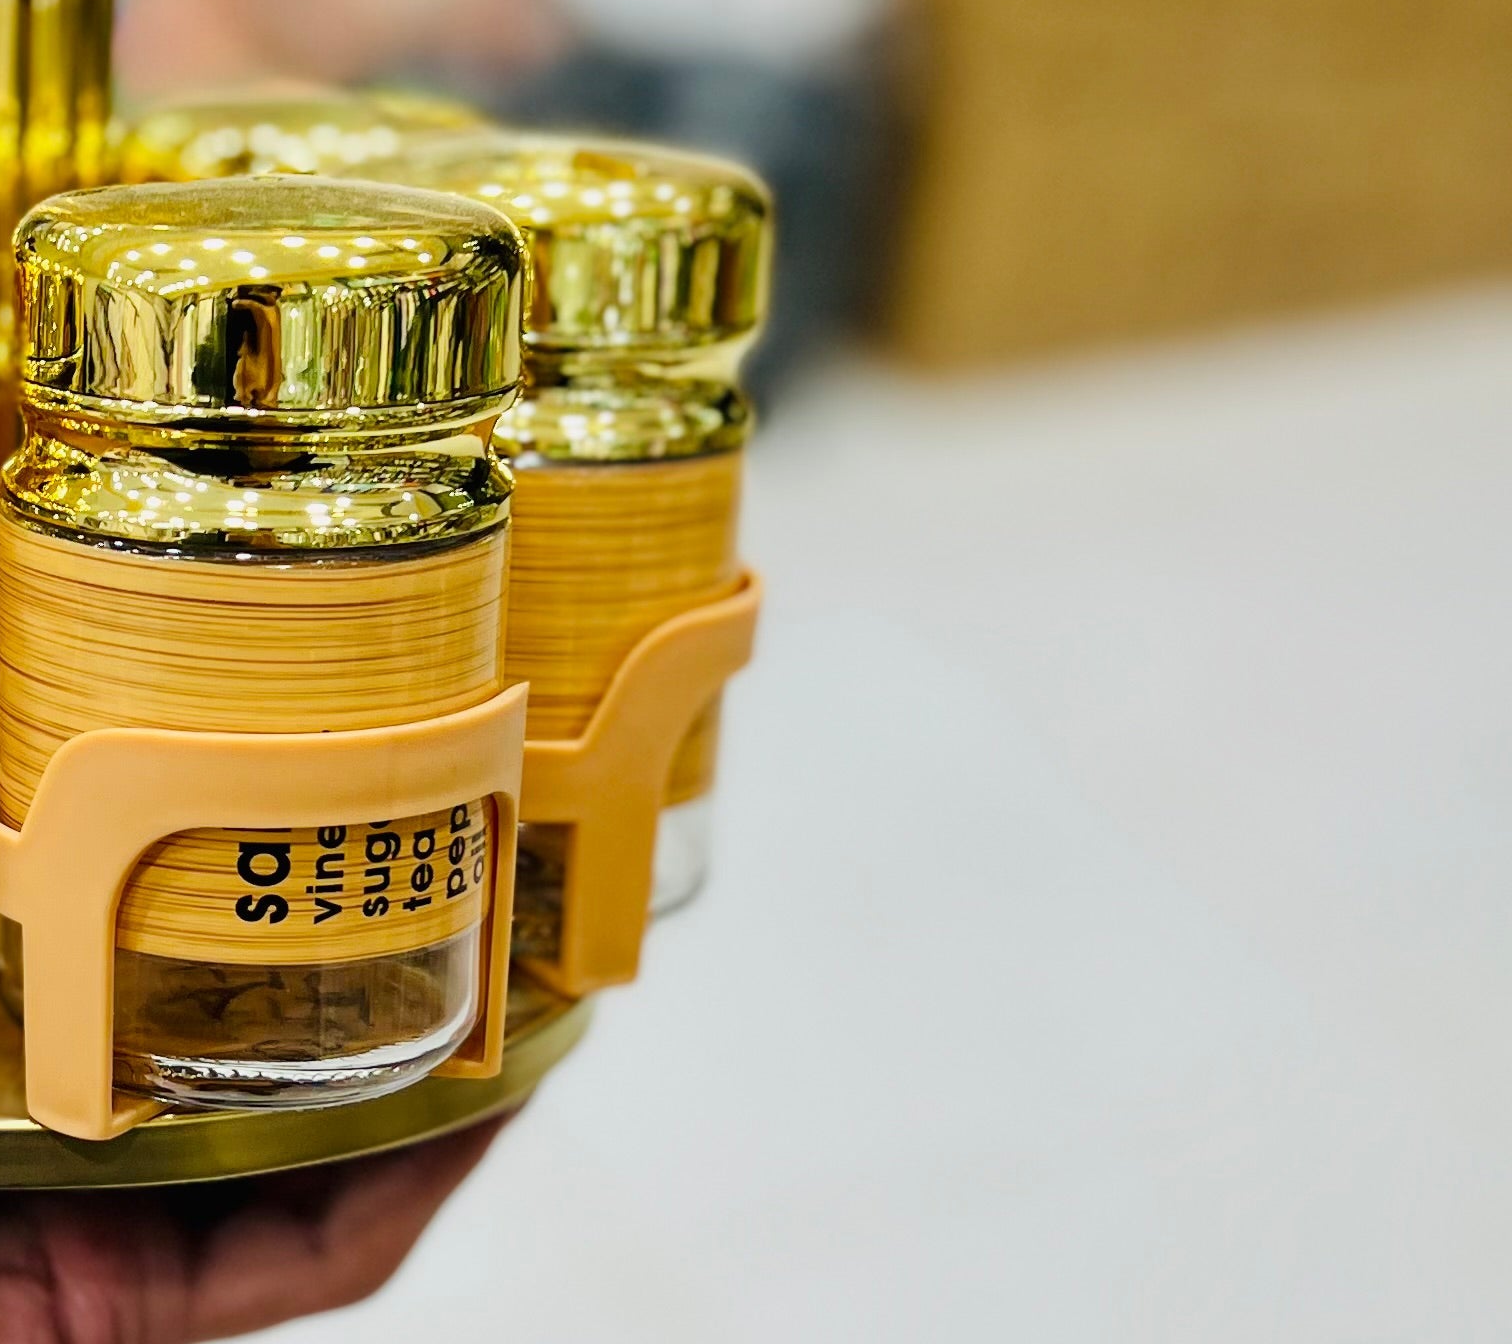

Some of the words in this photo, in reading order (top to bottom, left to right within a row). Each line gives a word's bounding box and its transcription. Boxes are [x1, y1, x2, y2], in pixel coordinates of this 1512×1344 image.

[223, 827, 291, 924] sa
[403, 828, 436, 911] tea
[470, 824, 487, 885] oil
